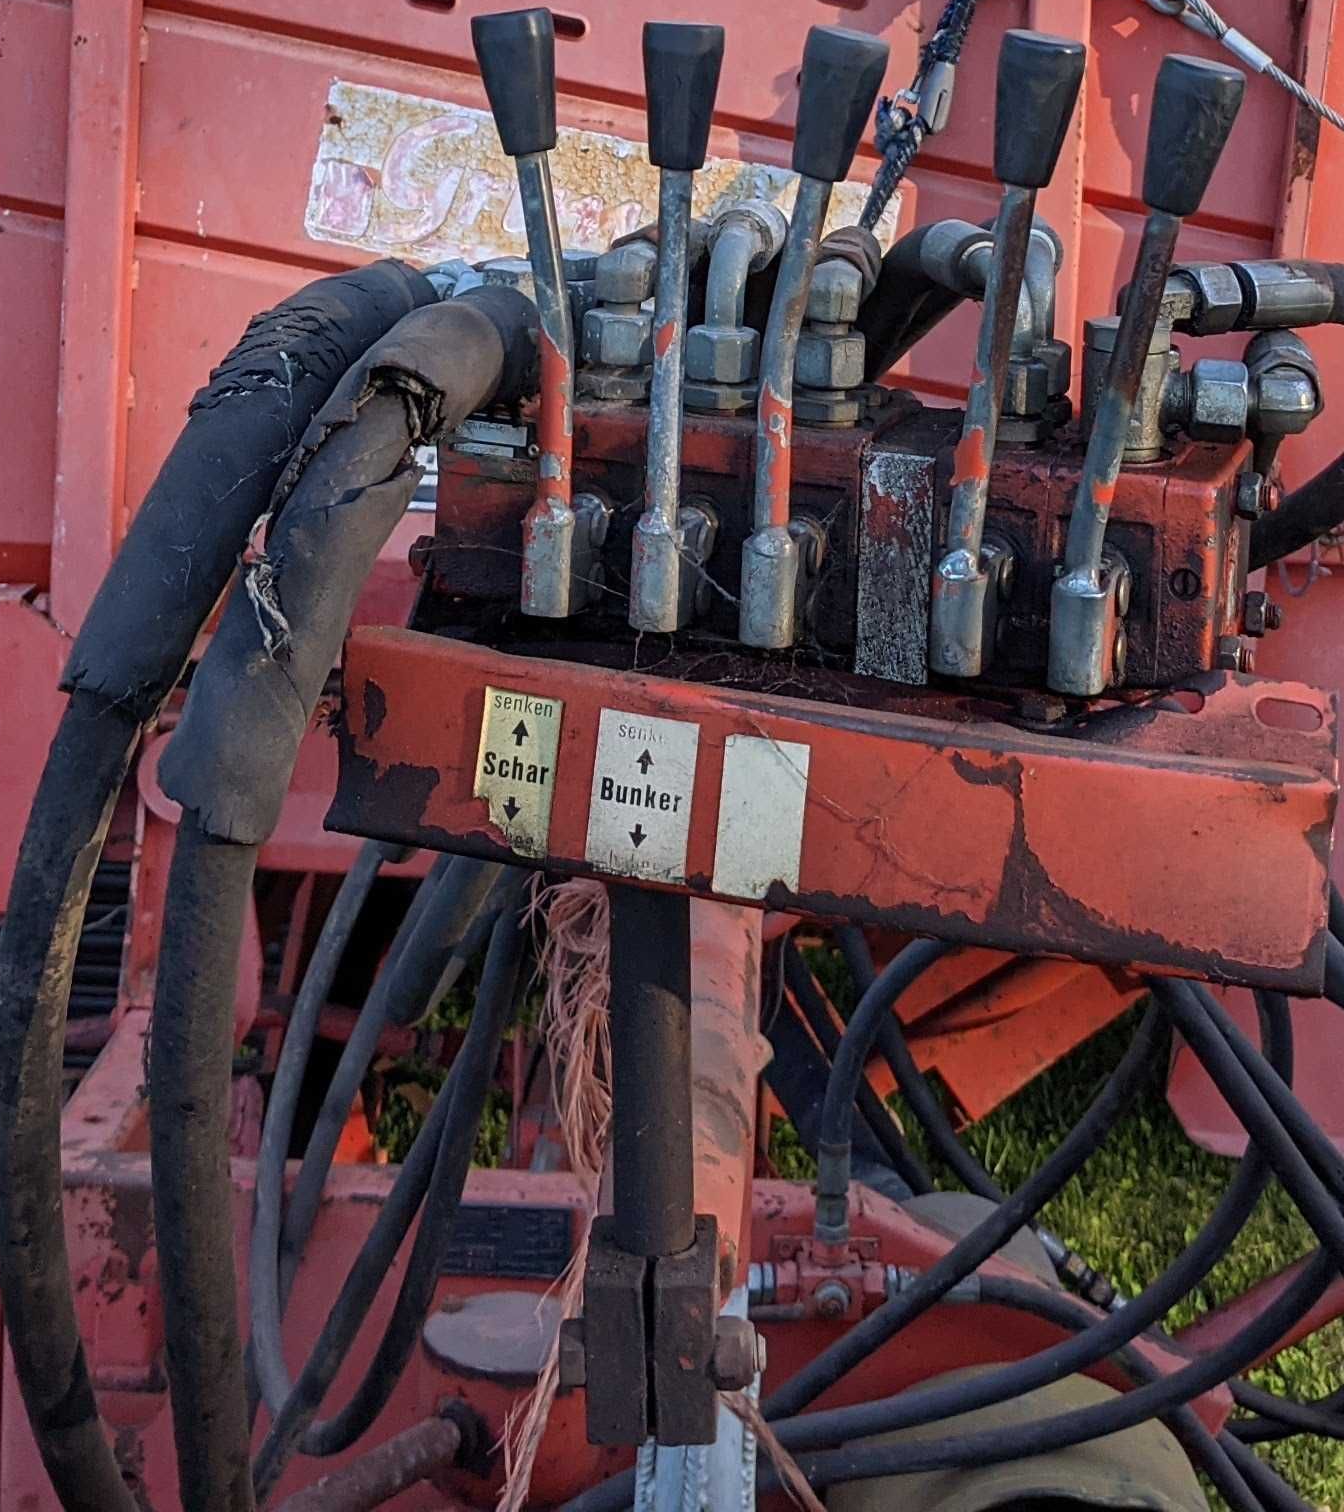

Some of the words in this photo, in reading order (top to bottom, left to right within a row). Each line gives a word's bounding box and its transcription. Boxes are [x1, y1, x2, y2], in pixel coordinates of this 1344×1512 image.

[494, 694, 553, 718] senken
[483, 751, 549, 785] Schar
[600, 776, 683, 813] Bunker
